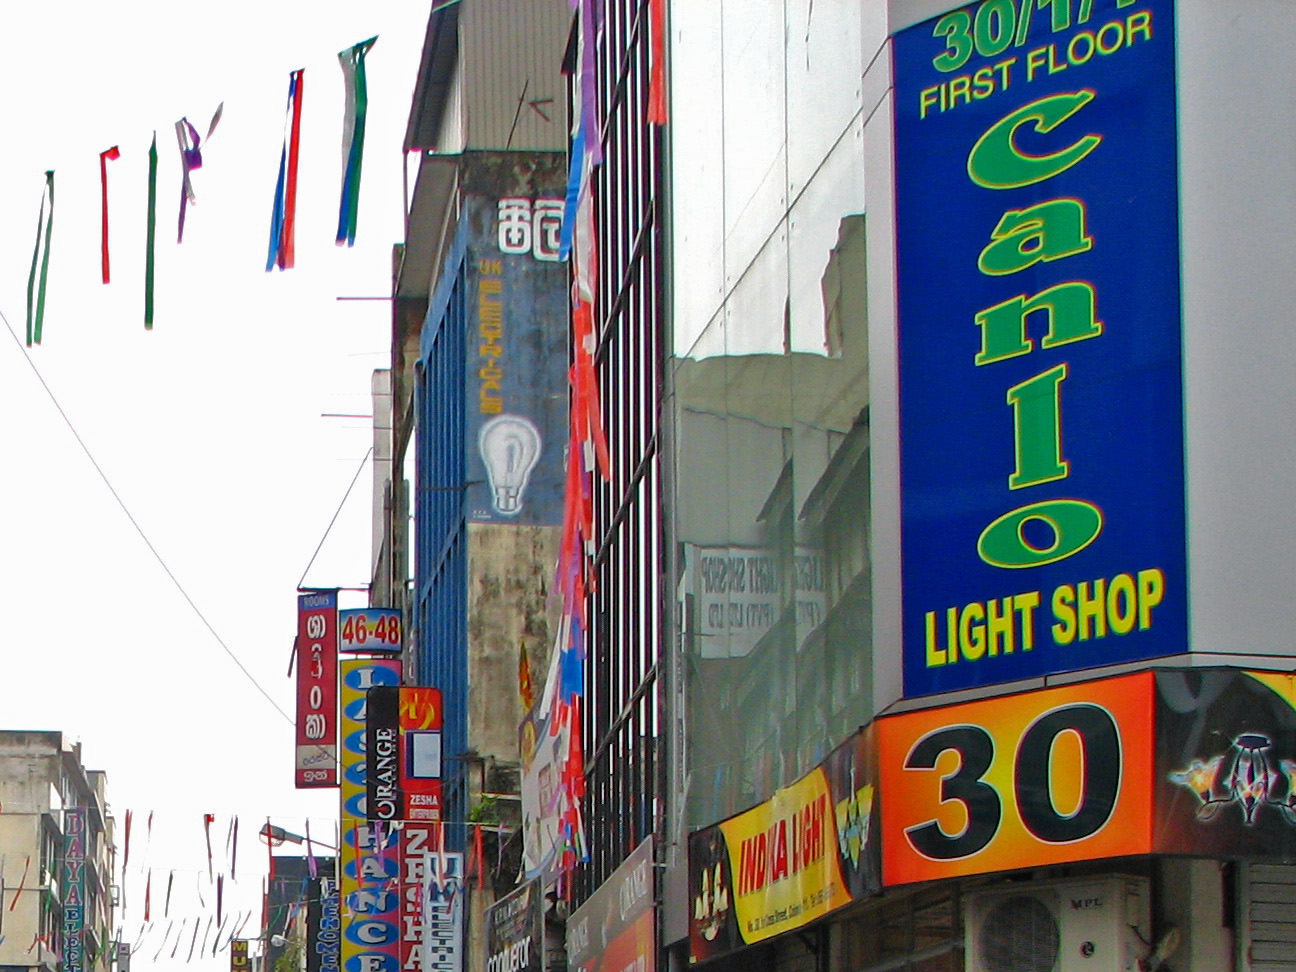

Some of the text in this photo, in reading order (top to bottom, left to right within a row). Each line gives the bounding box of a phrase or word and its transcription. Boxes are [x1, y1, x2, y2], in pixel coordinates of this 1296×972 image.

[919, 11, 1152, 119] FIRST FLOOR
[967, 89, 1102, 569] Canlo
[342, 614, 400, 646] 46-48
[924, 568, 1165, 668] LIGHT SHOP
[410, 794, 439, 806] ZESHA
[904, 702, 1123, 861] 30
